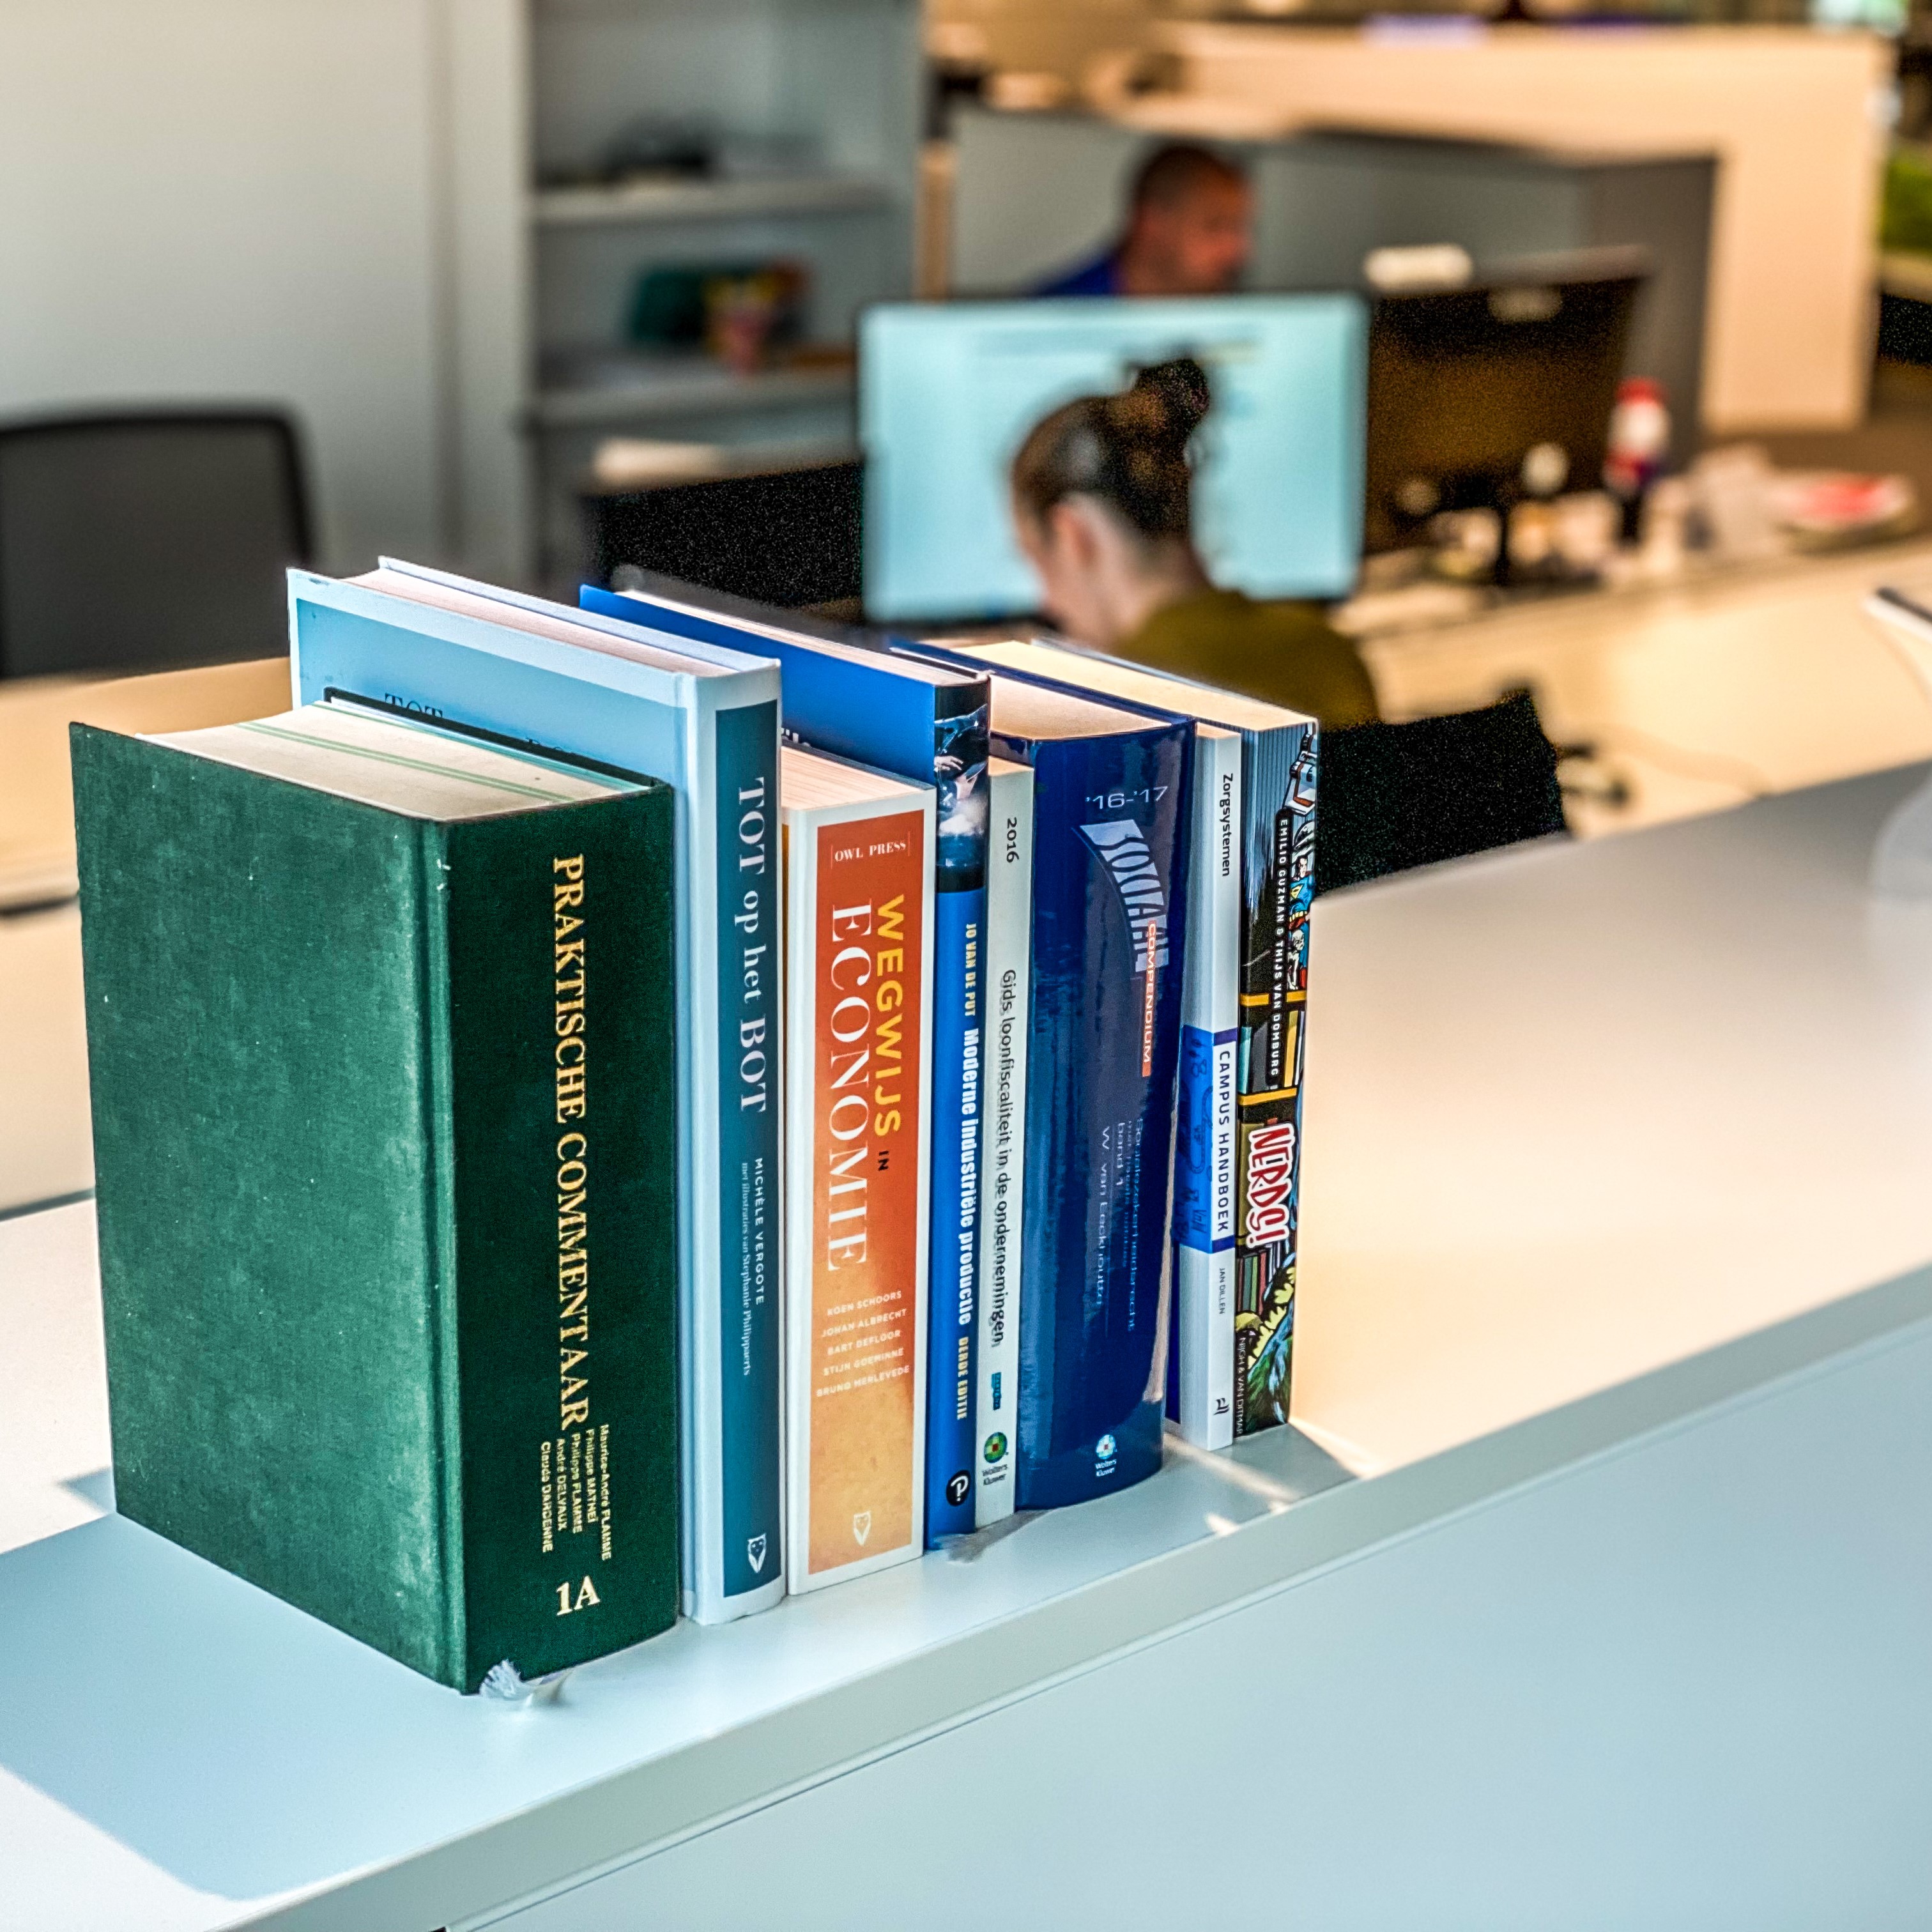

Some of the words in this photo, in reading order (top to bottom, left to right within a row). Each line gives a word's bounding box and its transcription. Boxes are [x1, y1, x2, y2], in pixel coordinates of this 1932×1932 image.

[738, 776, 765, 875] TOT
[834, 847, 863, 862] OWL
[869, 839, 907, 856] PRESS
[1006, 816, 1020, 864] 2016
[1219, 773, 1233, 877] Zorgsystemen
[1278, 818, 1288, 864] EMILIO
[735, 890, 758, 933] op
[1275, 870, 1286, 923] GUZMAN
[744, 944, 767, 1004] het
[965, 941, 977, 969] VAN
[965, 971, 976, 989] DE
[1273, 940, 1284, 980] THIJS
[553, 853, 586, 1124] PRAKTISCHE
[874, 894, 905, 1137] WEGWIJS
[964, 991, 976, 1016] PUT
[1002, 969, 1017, 1012] Gids
[1143, 923, 1157, 1063] COMPENDIUM
[1273, 983, 1282, 1009] VAN
[740, 1013, 766, 1112] BOT
[962, 1027, 979, 1116] Moderne
[1271, 1013, 1281, 1076] DOMBURG
[827, 898, 871, 1271] ECONOMIE
[999, 1016, 1016, 1146] loonfiscaliteit
[1217, 1050, 1230, 1126] CAMPUS
[878, 1150, 889, 1172] IN
[997, 1172, 1011, 1195] de
[998, 1148, 1011, 1166] in
[1216, 1133, 1229, 1232] HANDBOEK
[755, 1157, 765, 1226] MICHÈLE
[1248, 1124, 1292, 1247] NERDS!
[556, 1132, 589, 1431] COMMENTAAR
[740, 1254, 751, 1308] Stephanie
[755, 1231, 765, 1305] VERGOTE
[958, 1230, 974, 1326] productie
[991, 1200, 1011, 1343] ondernemingen
[822, 1322, 855, 1337] JOHAN
[857, 1308, 907, 1328] ALBRECHT
[827, 1302, 855, 1316] KOEN
[857, 1290, 902, 1309] SCHOORS
[823, 1362, 851, 1376] STIJN
[827, 1342, 853, 1356] BART
[556, 1575, 601, 1616] 1A
